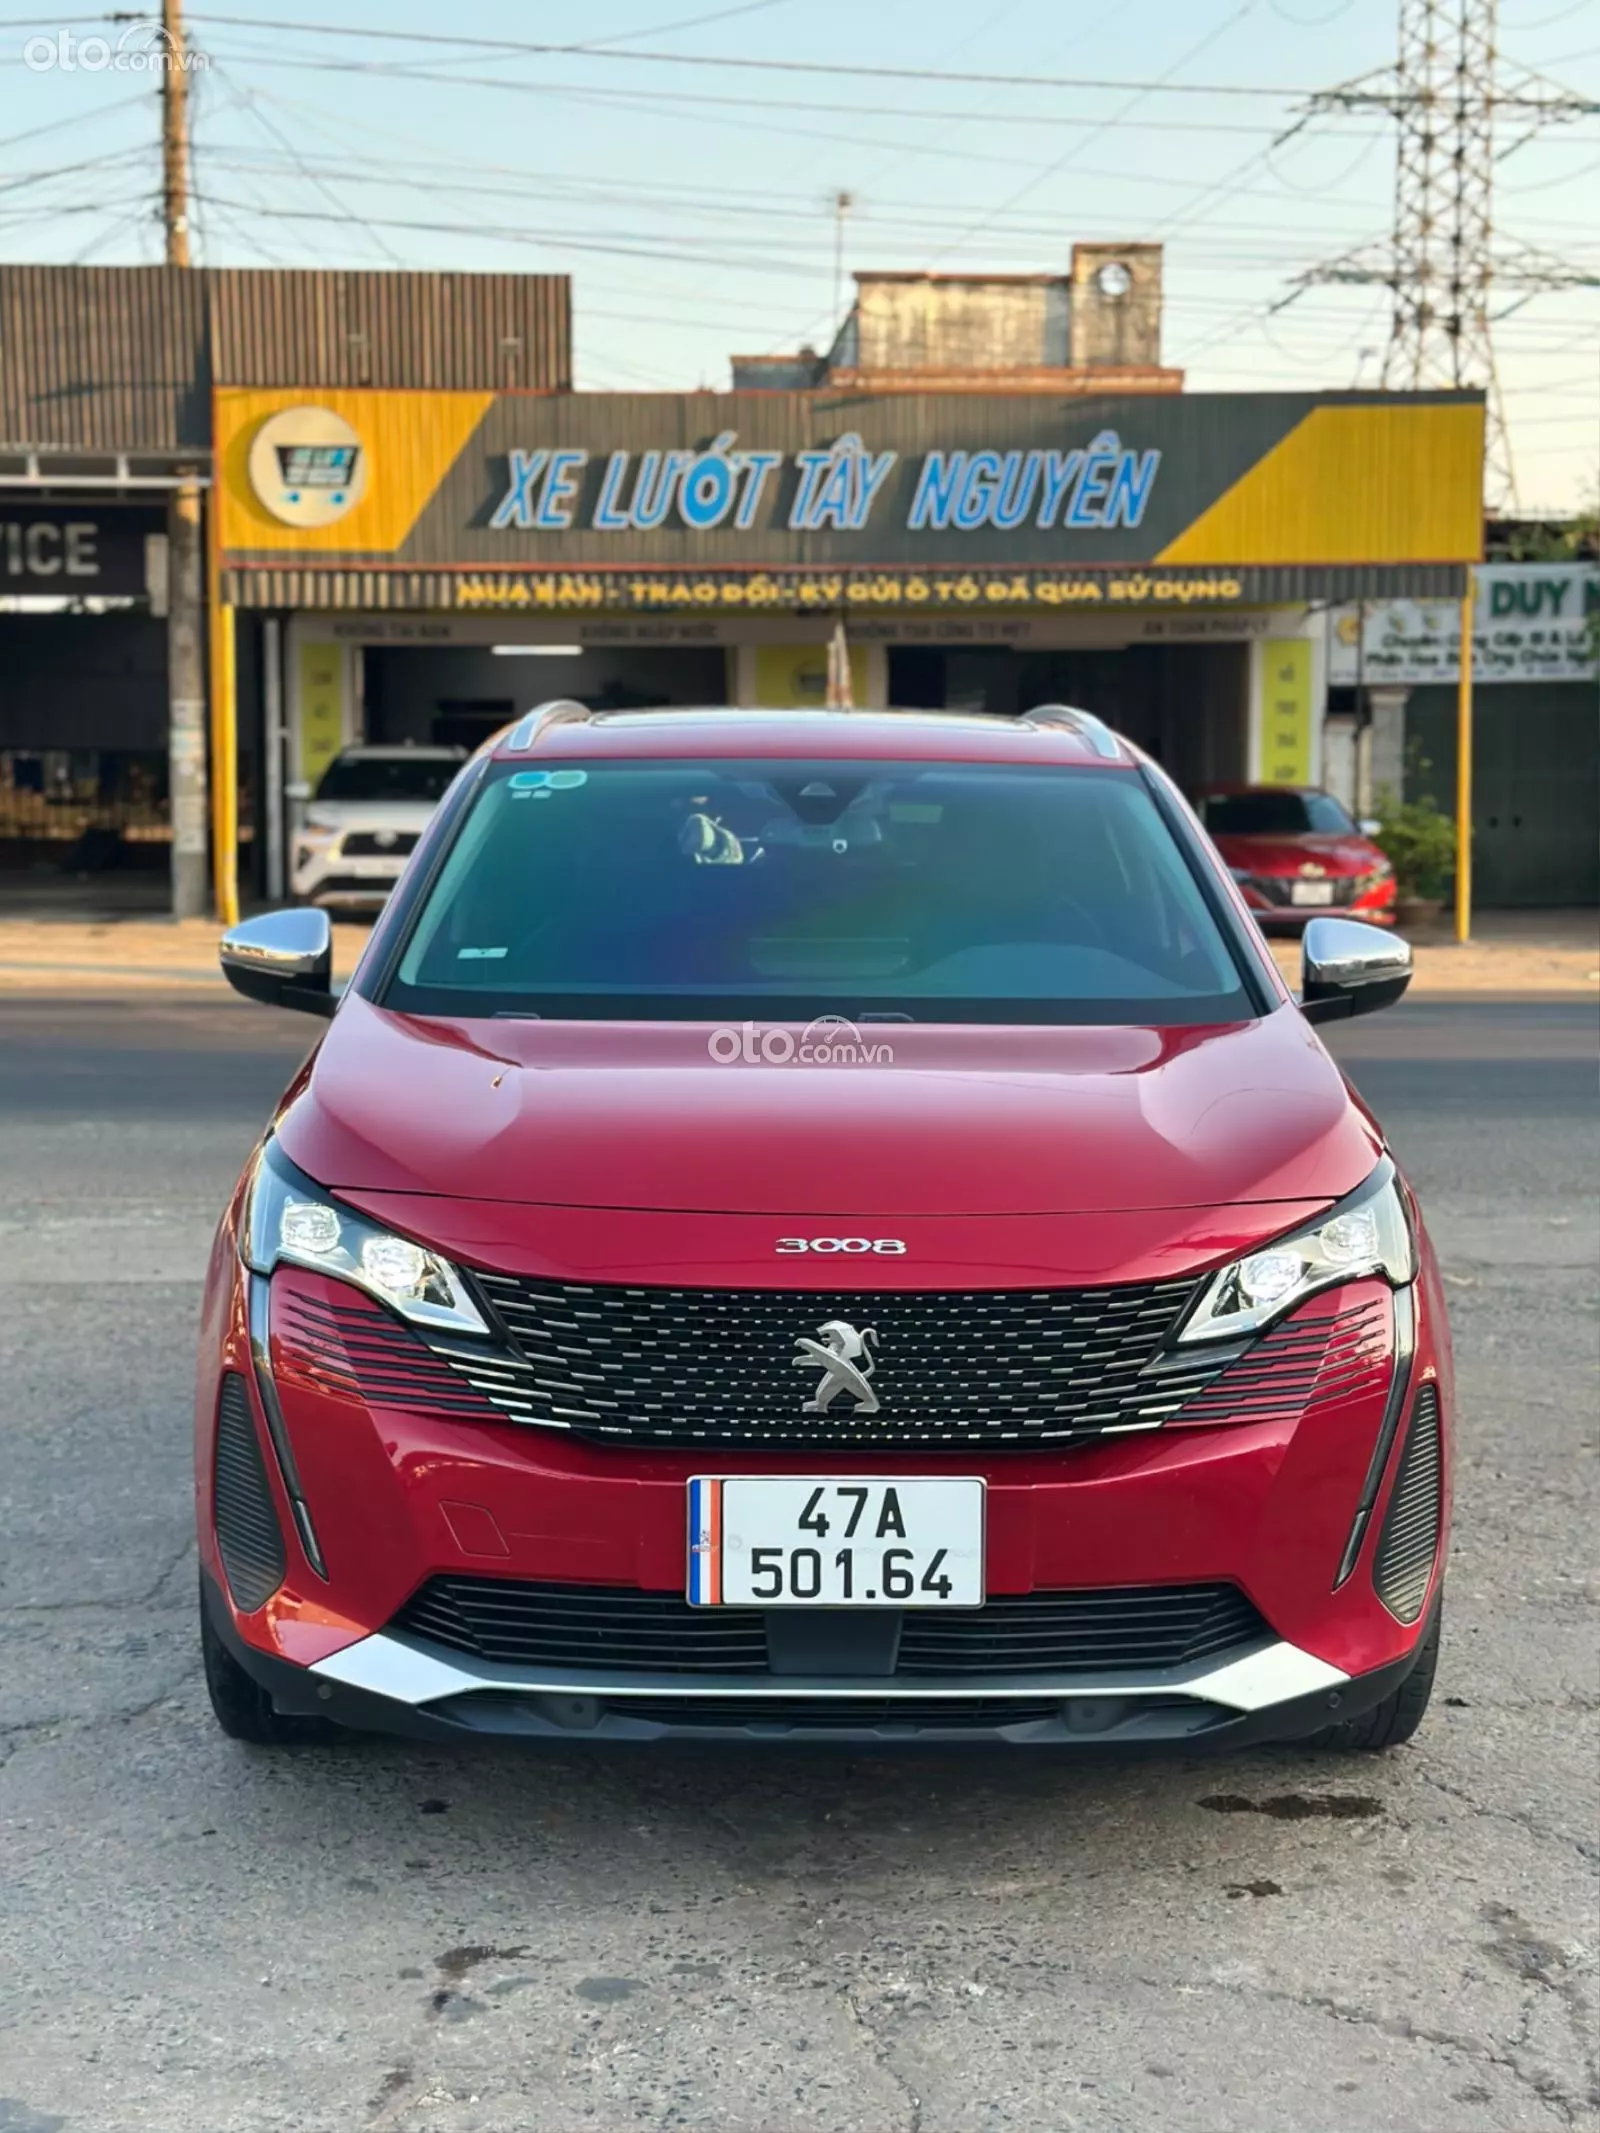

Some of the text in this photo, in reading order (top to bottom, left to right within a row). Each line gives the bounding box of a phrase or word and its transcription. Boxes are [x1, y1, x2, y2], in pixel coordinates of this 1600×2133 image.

[488, 429, 1161, 530] XE LƯỚT TÂY NGUYÊN
[0, 522, 100, 576] ICE
[456, 583, 530, 603] MUA
[631, 583, 718, 603] TRAO
[1035, 580, 1104, 604] QUA
[1490, 578, 1571, 617] DUY
[775, 1237, 908, 1255] 3008
[798, 1487, 906, 1538] 47A
[751, 1547, 953, 1599] 501.64
